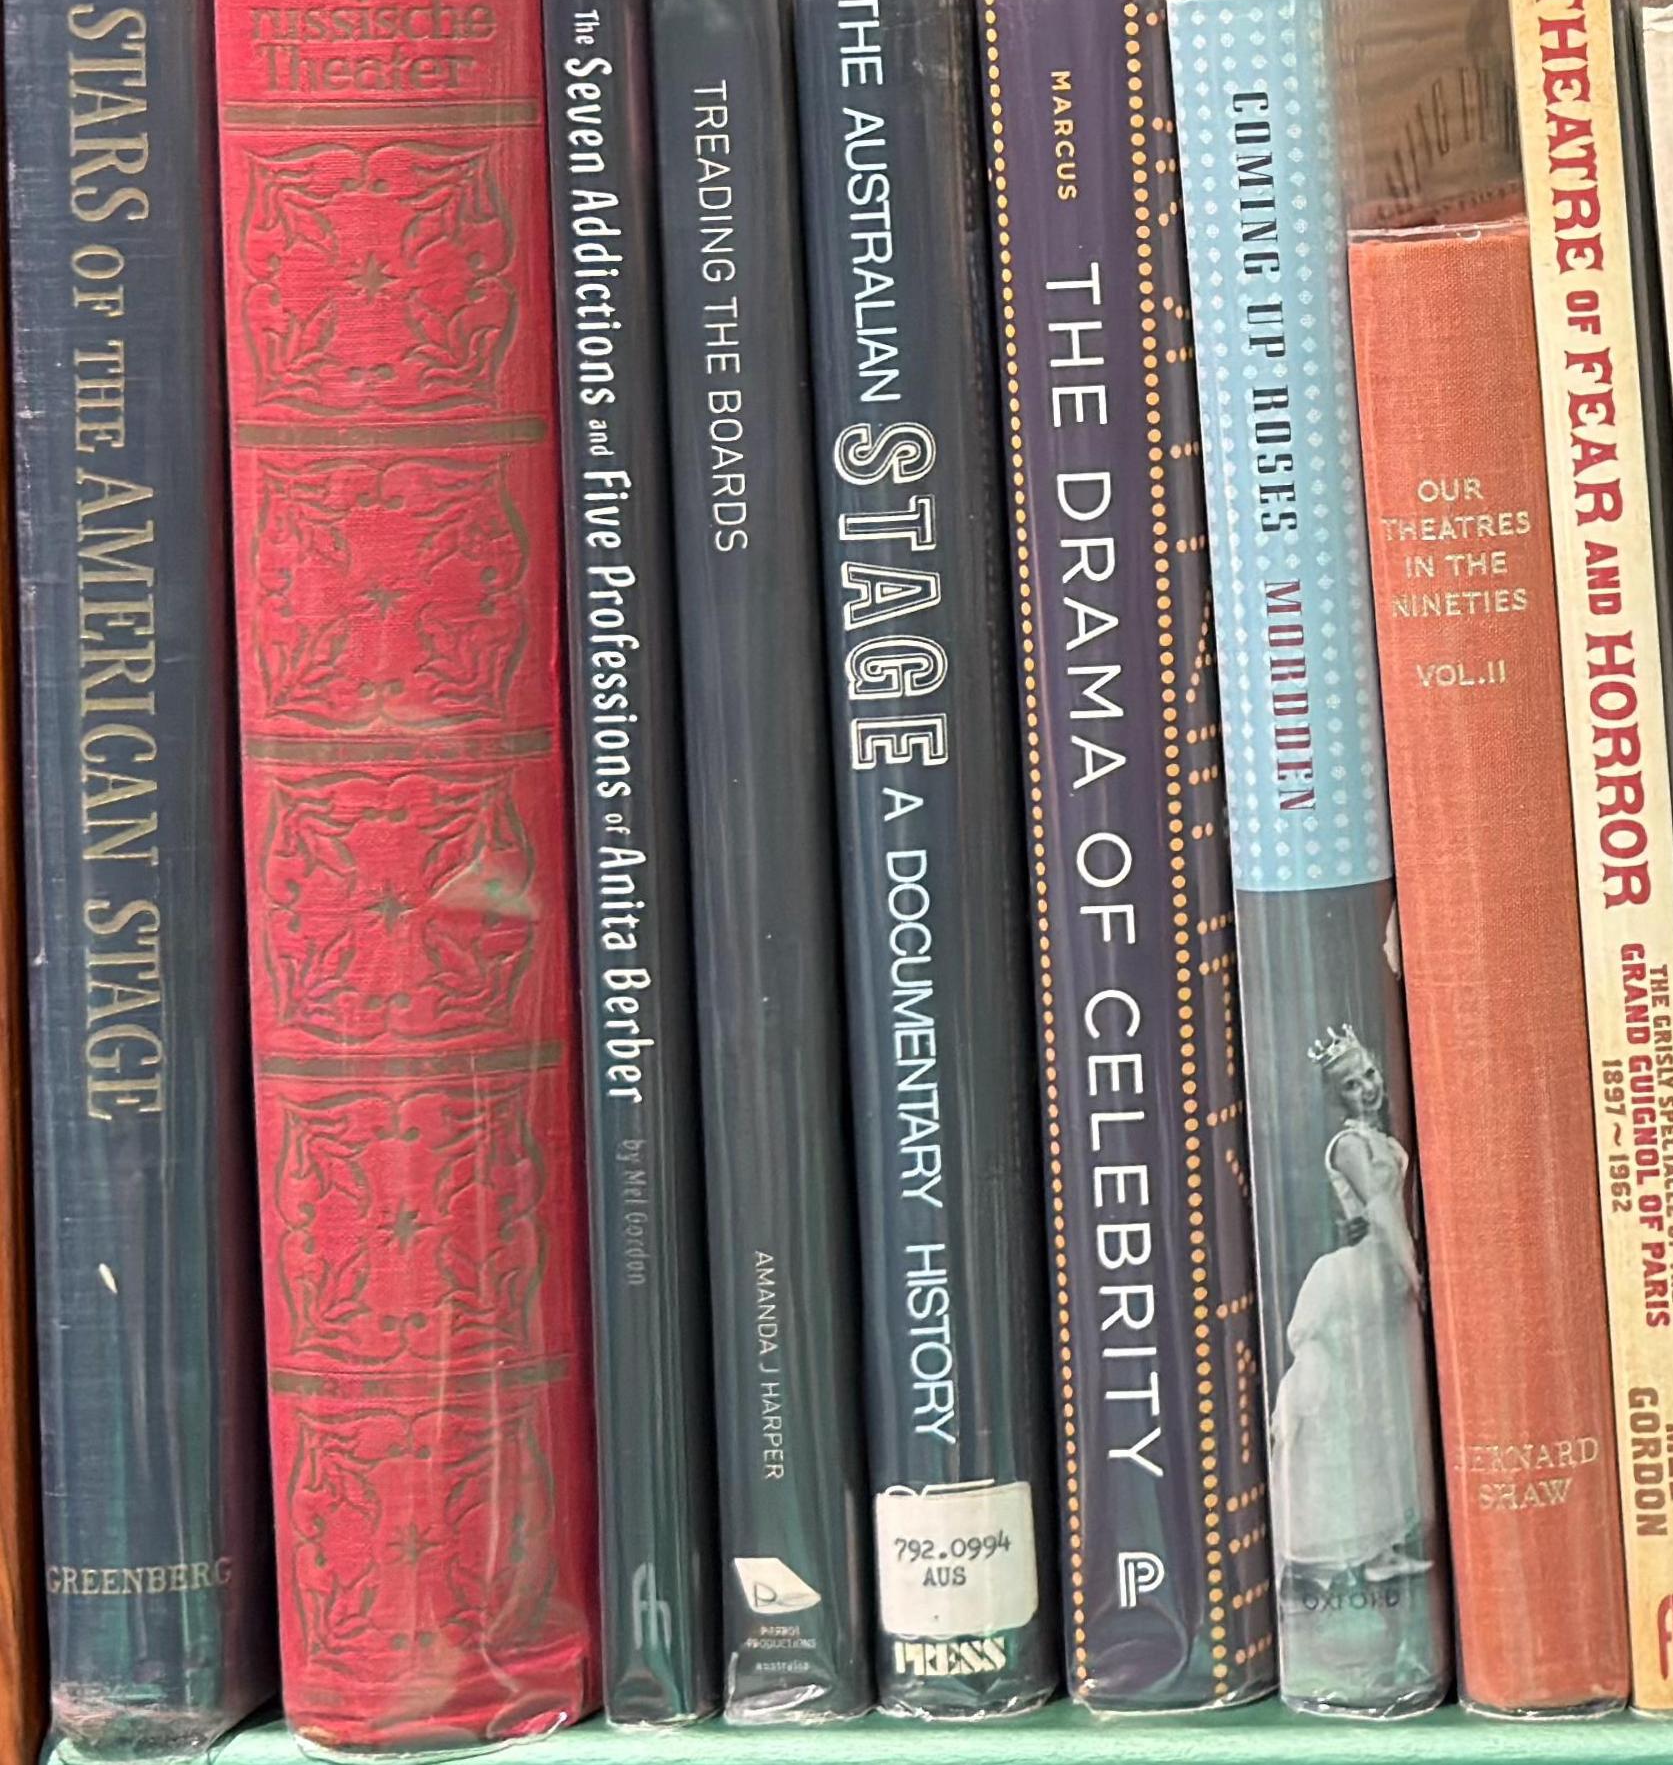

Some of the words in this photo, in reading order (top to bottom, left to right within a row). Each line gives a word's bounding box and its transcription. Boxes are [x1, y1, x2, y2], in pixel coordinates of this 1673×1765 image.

[258, 43, 477, 92] Theater
[573, 9, 598, 45] The
[68, 3, 150, 224] STARS
[565, 56, 604, 174] Seven
[1050, 70, 1077, 200] MARCUS
[692, 78, 736, 284] TREADING
[1231, 91, 1281, 276] COMING
[70, 244, 125, 317] OF
[571, 189, 621, 406] Addictions
[842, 108, 902, 403] AUSTRALIAN
[702, 296, 741, 374] THE
[1044, 262, 1109, 428] THE
[1245, 300, 1287, 359] UP
[1565, 289, 1601, 334] OF
[74, 340, 125, 454] THE
[589, 419, 613, 456] and
[1564, 347, 1624, 526] FEAR
[583, 468, 632, 549] Five
[707, 390, 749, 552] BOARDS
[1252, 385, 1298, 533] ROSES
[1417, 476, 1484, 503] OUR
[1380, 511, 1532, 541] THEATRES
[1405, 555, 1435, 579] IN
[1445, 551, 1508, 576] THE
[1584, 540, 1623, 616] AND
[833, 421, 949, 771] STAGE
[1056, 471, 1127, 789] DRAMA
[1391, 588, 1529, 618] NINETIES
[76, 467, 159, 866] AMERICAN
[587, 564, 641, 800] Professions
[1264, 579, 1317, 813] MORDDEN
[882, 787, 924, 822] A
[1585, 631, 1652, 909] HORROR
[598, 845, 647, 953] Anita
[1076, 832, 1137, 945] OF
[83, 897, 165, 1122] STAGE
[603, 967, 655, 1105] Berber
[885, 848, 942, 1209] DOCUMENTARY
[1621, 943, 1650, 1044] GRAND
[1650, 964, 1670, 1007] THE
[1602, 1059, 1626, 1116] 1897
[1628, 1055, 1660, 1185] GUIGNOL
[1084, 989, 1164, 1478] CELEBRITY
[1609, 1154, 1632, 1213] 1962
[1638, 1194, 1664, 1231] OF
[754, 1251, 778, 1356] AMANDA
[1642, 1241, 1670, 1327] PARIS
[905, 1244, 955, 1445] HISTORY
[760, 1382, 784, 1479] HARPER
[1626, 1387, 1669, 1536] GORDON
[894, 1532, 1012, 1562] 792.0994
[1477, 1478, 1574, 1510] SHAW
[47, 1558, 232, 1596] GREENBERG
[922, 1565, 967, 1587] AUS
